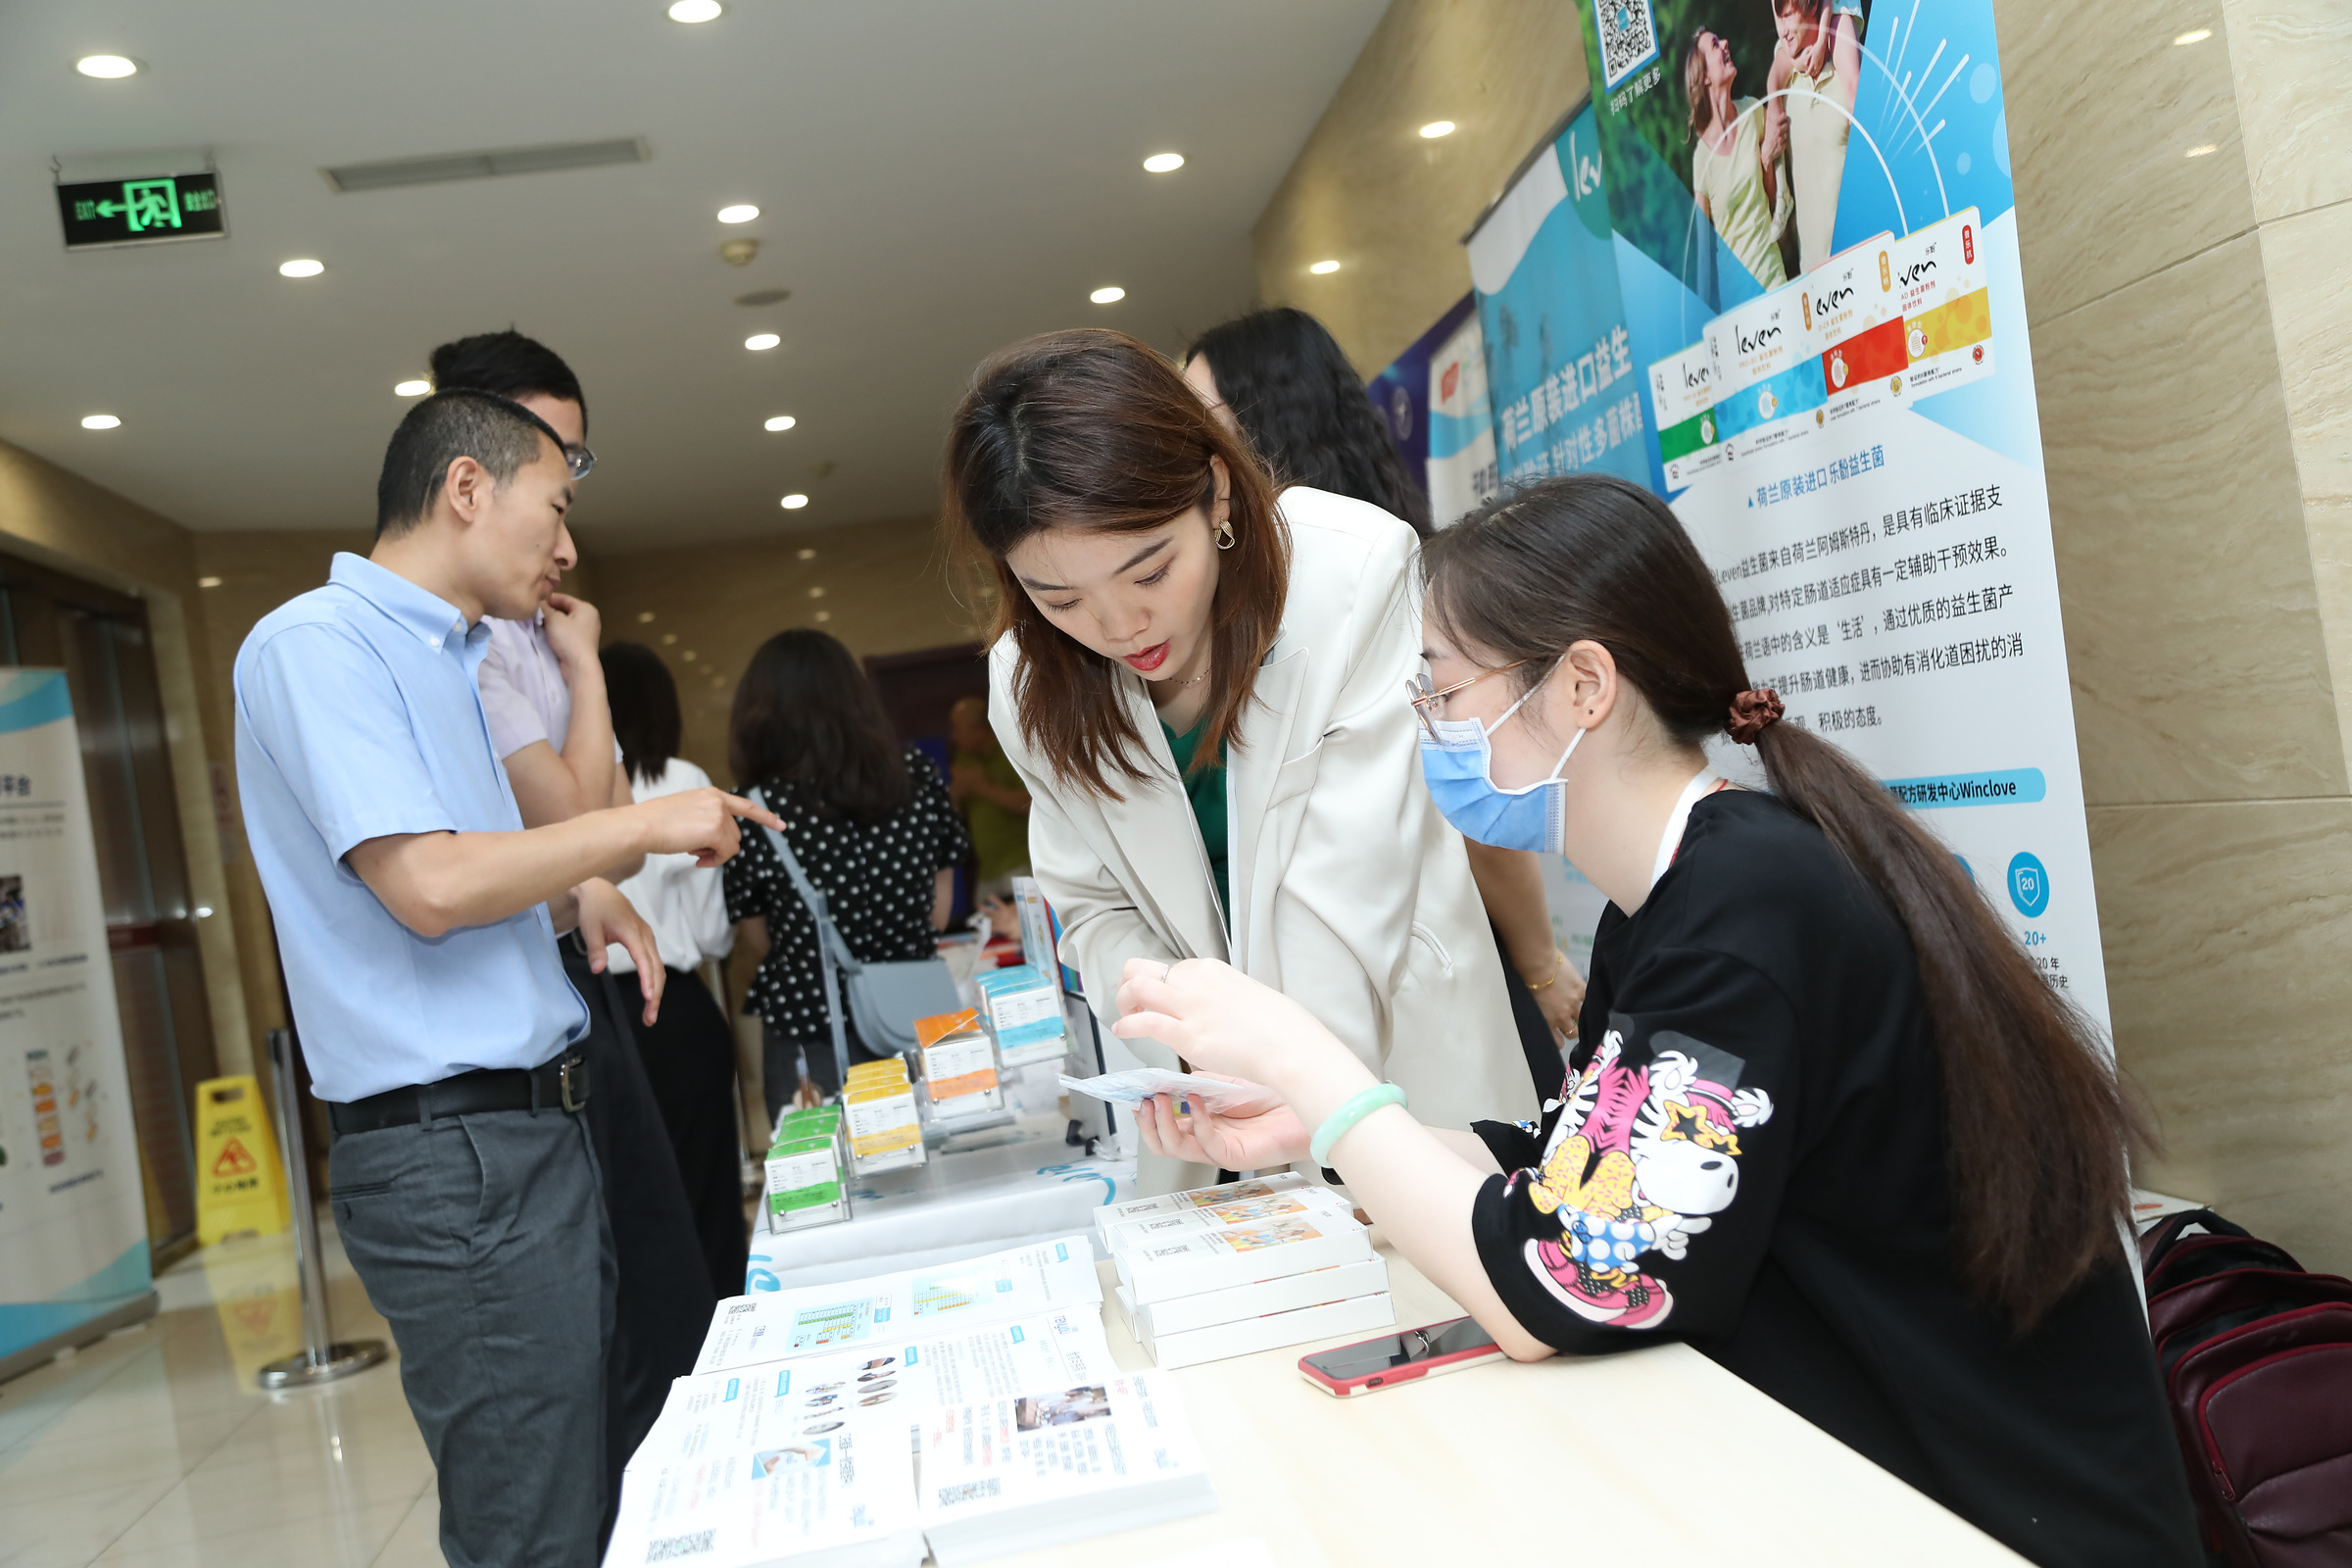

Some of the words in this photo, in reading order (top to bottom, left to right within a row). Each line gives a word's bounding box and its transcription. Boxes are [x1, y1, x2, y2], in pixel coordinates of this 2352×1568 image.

[1610, 67, 1661, 116] 扫码了解更多
[1898, 261, 1936, 288] ven
[1816, 286, 1854, 317] even
[1736, 324, 1782, 356] leven
[1501, 323, 1633, 453] 荷兰原装进口益生
[1756, 467, 1828, 508] 荷兰原装进口
[1728, 536, 2007, 622] 生菌品牌,对特定肠道适应症具有一定辅助干预效果。
[2021, 877, 2034, 891] 20
[2025, 931, 2047, 946] 20+
[2050, 956, 2060, 970] 年
